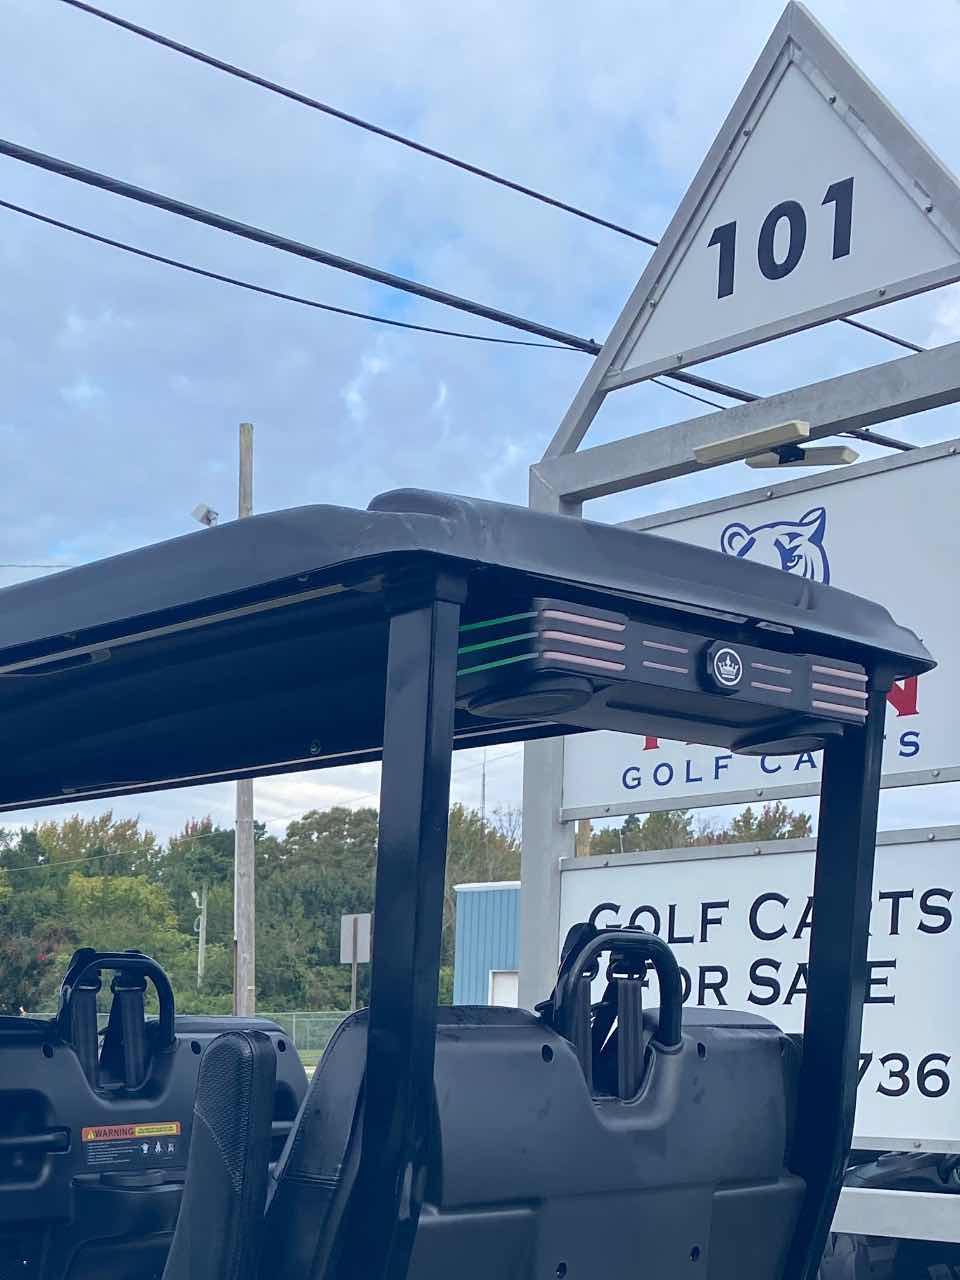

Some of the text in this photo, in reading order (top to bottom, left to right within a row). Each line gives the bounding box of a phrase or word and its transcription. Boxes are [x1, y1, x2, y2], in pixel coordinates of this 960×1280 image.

[707, 176, 854, 299] 101
[622, 754, 733, 790] GOLF
[747, 957, 897, 1006] SAE
[95, 1126, 134, 1138] WARNING
